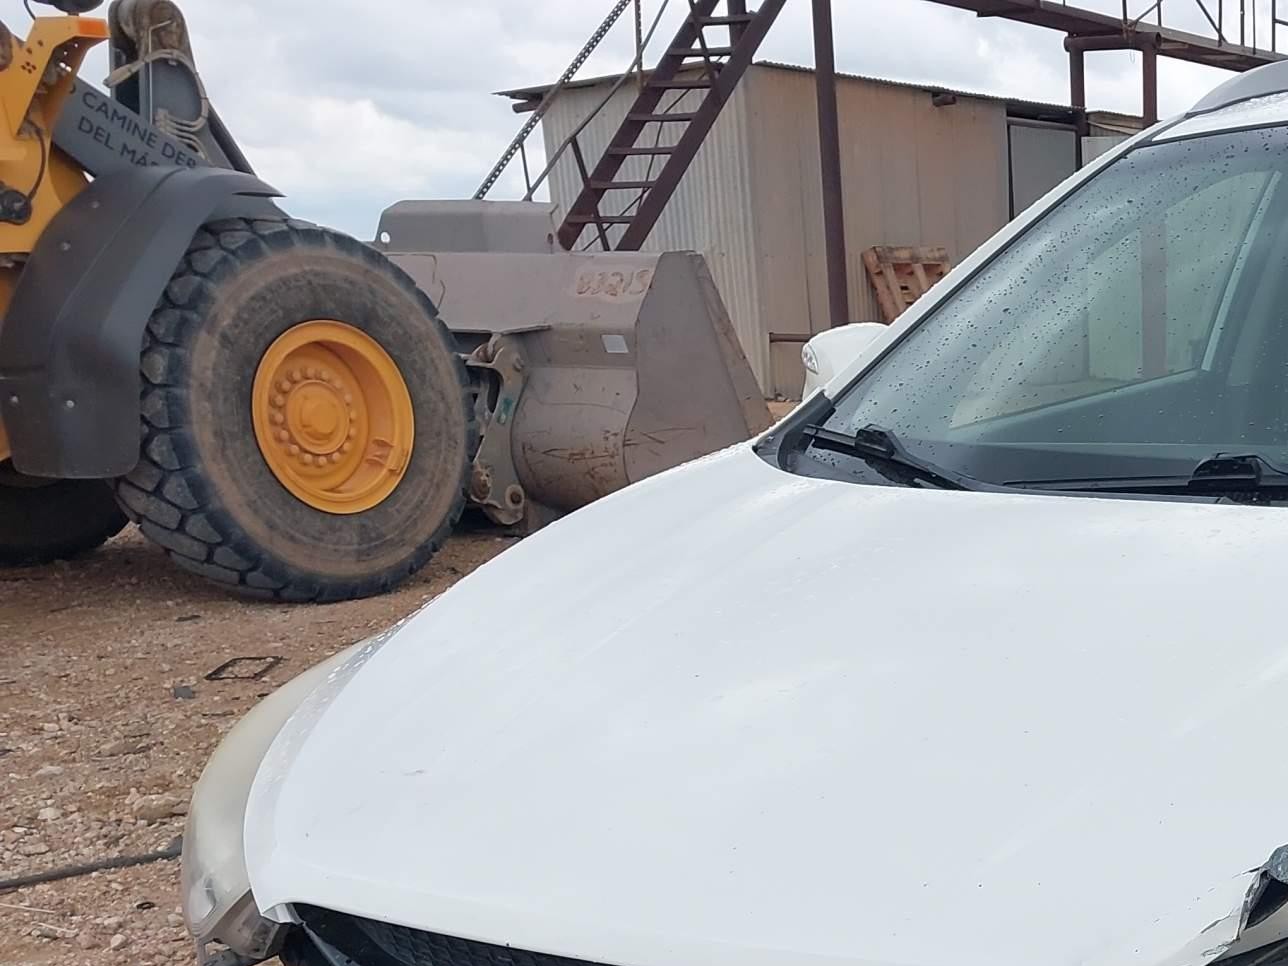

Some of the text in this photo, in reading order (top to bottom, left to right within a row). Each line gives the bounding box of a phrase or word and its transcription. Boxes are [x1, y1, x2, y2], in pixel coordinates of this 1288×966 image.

[77, 116, 160, 167] DEL MÁ
[82, 92, 158, 148] CAMINE
